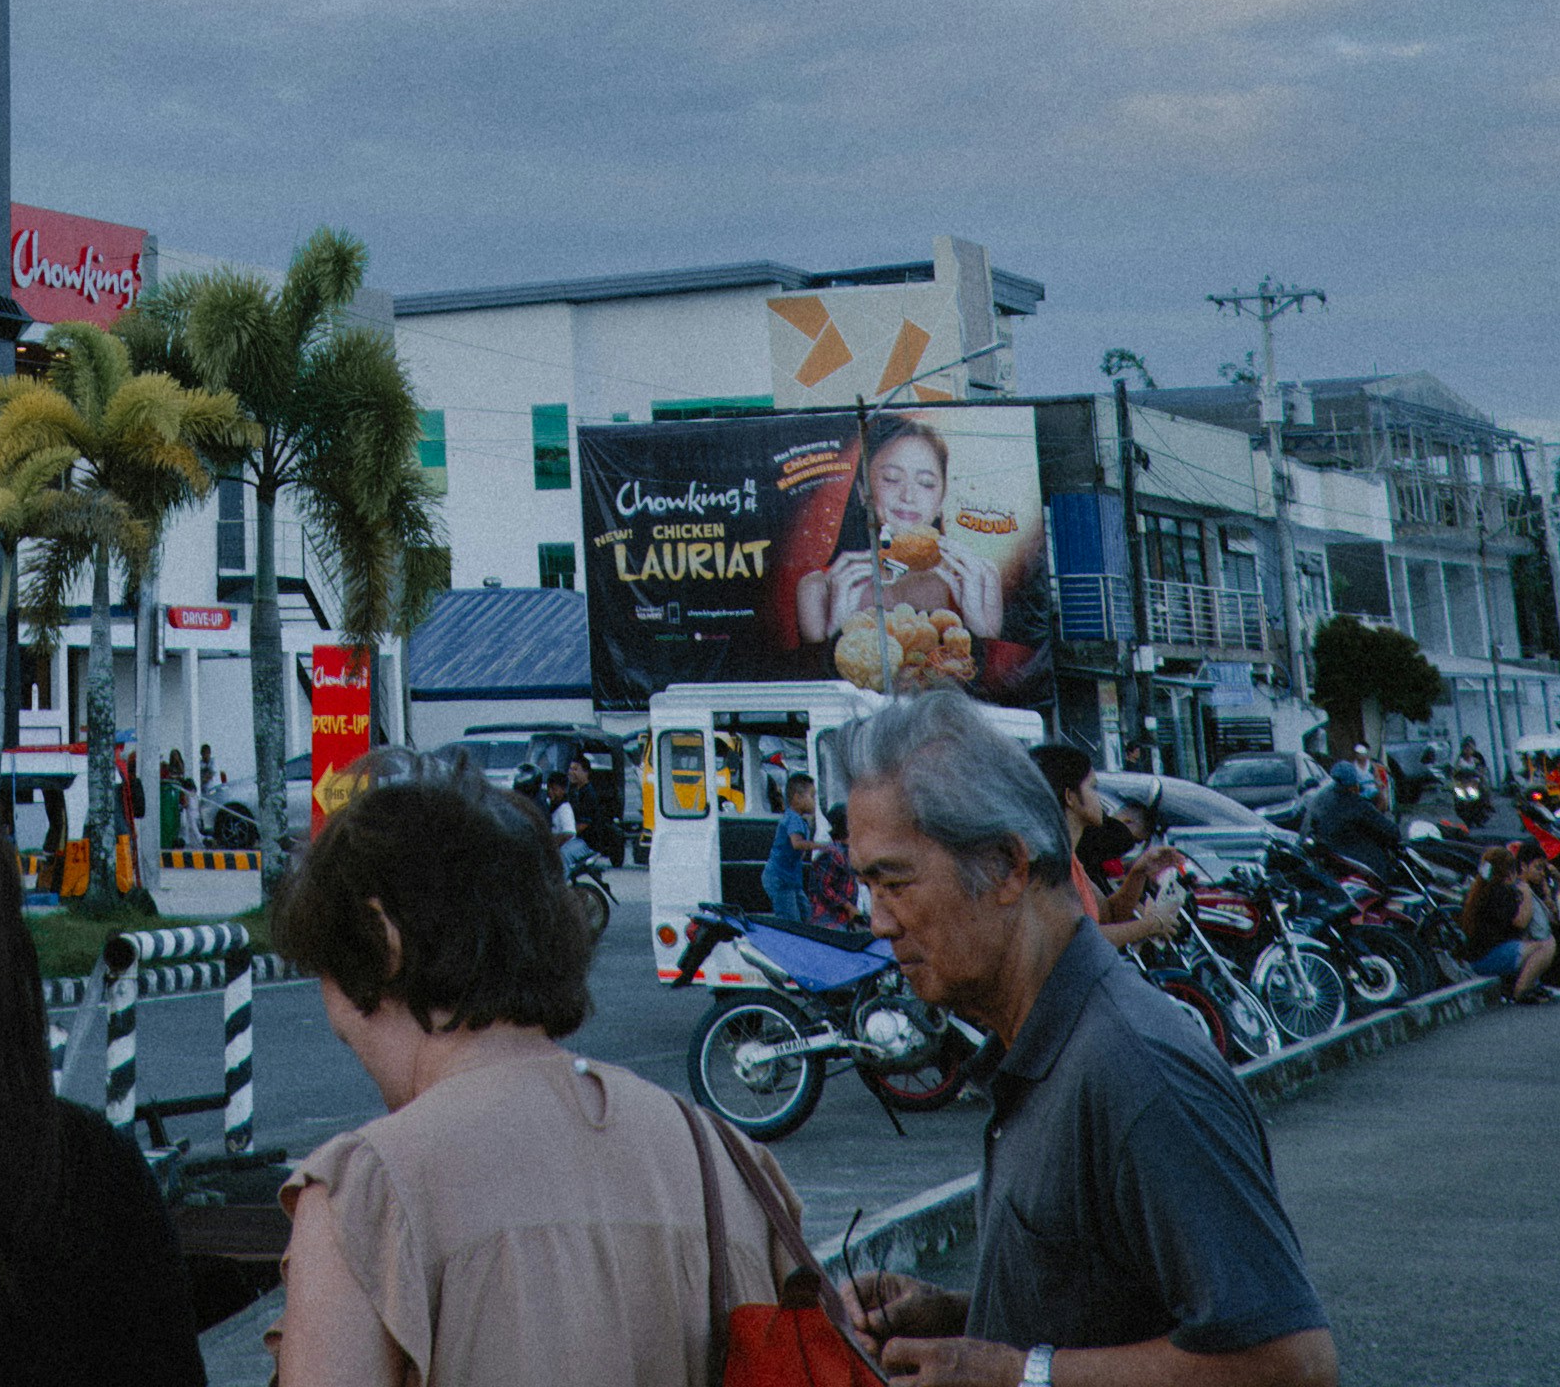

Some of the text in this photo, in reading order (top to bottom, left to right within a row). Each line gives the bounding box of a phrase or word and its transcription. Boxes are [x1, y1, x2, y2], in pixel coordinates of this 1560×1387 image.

[13, 229, 134, 309] Chowking
[615, 480, 741, 517] Chowking
[652, 522, 725, 540] CHICKEN
[957, 512, 1018, 534] CHOW!
[594, 528, 634, 548] NEW!
[616, 541, 771, 582] LAURIAT
[181, 610, 224, 626] DRIVE-UP
[312, 714, 369, 735] DRIVE-UP
[773, 1036, 811, 1054] YAMAHA
